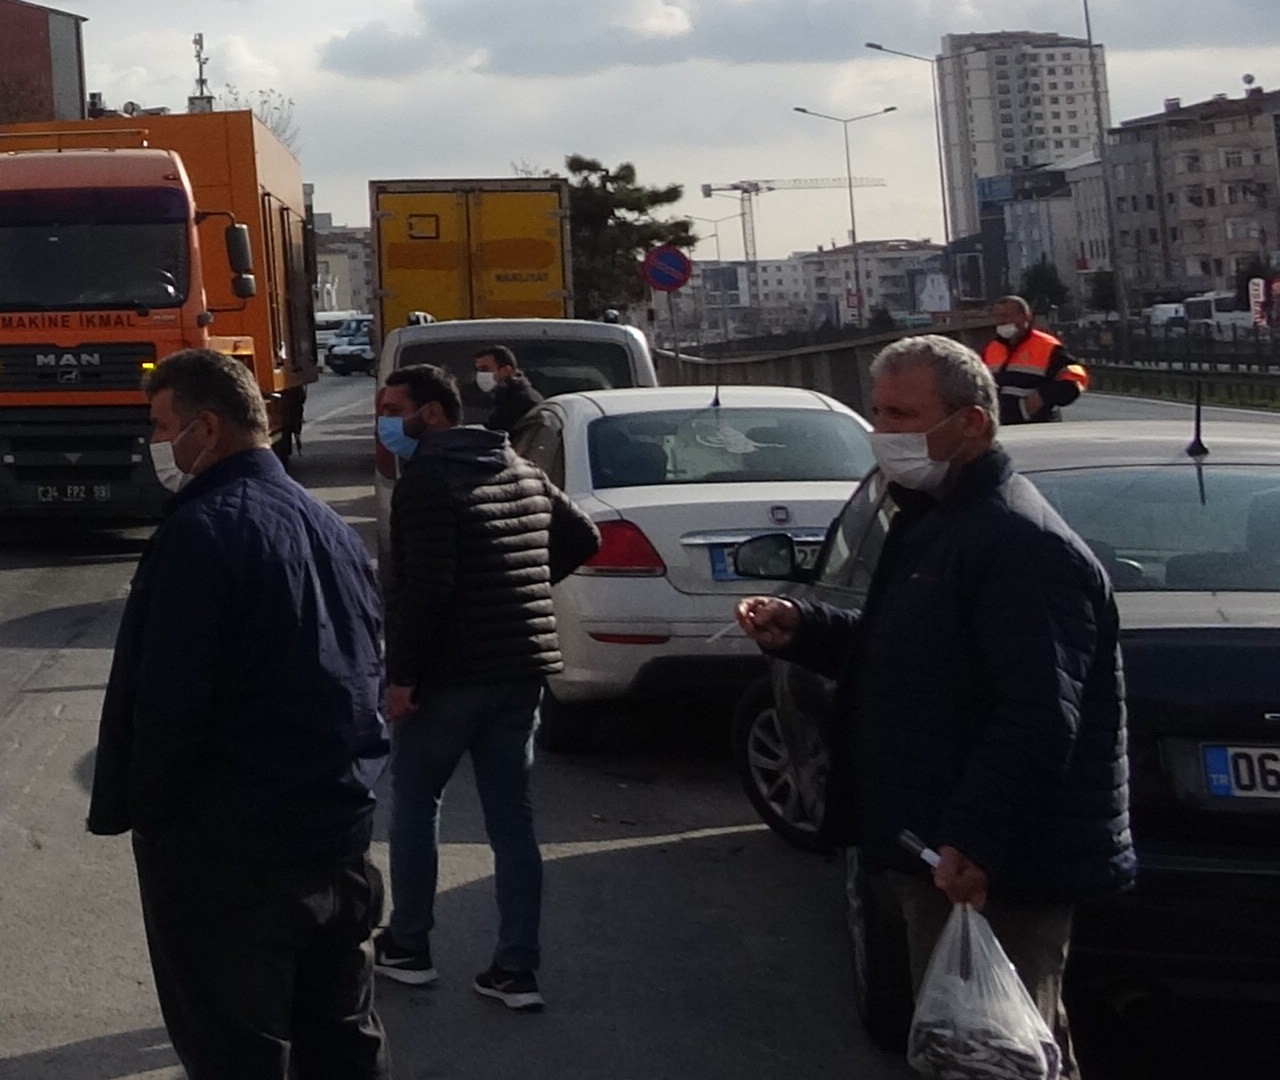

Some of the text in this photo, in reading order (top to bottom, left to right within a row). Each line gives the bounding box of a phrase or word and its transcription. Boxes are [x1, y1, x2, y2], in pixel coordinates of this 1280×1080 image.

[1, 313, 70, 329] MAKİNE
[79, 312, 136, 328] İKMAL
[36, 353, 101, 366] MAN
